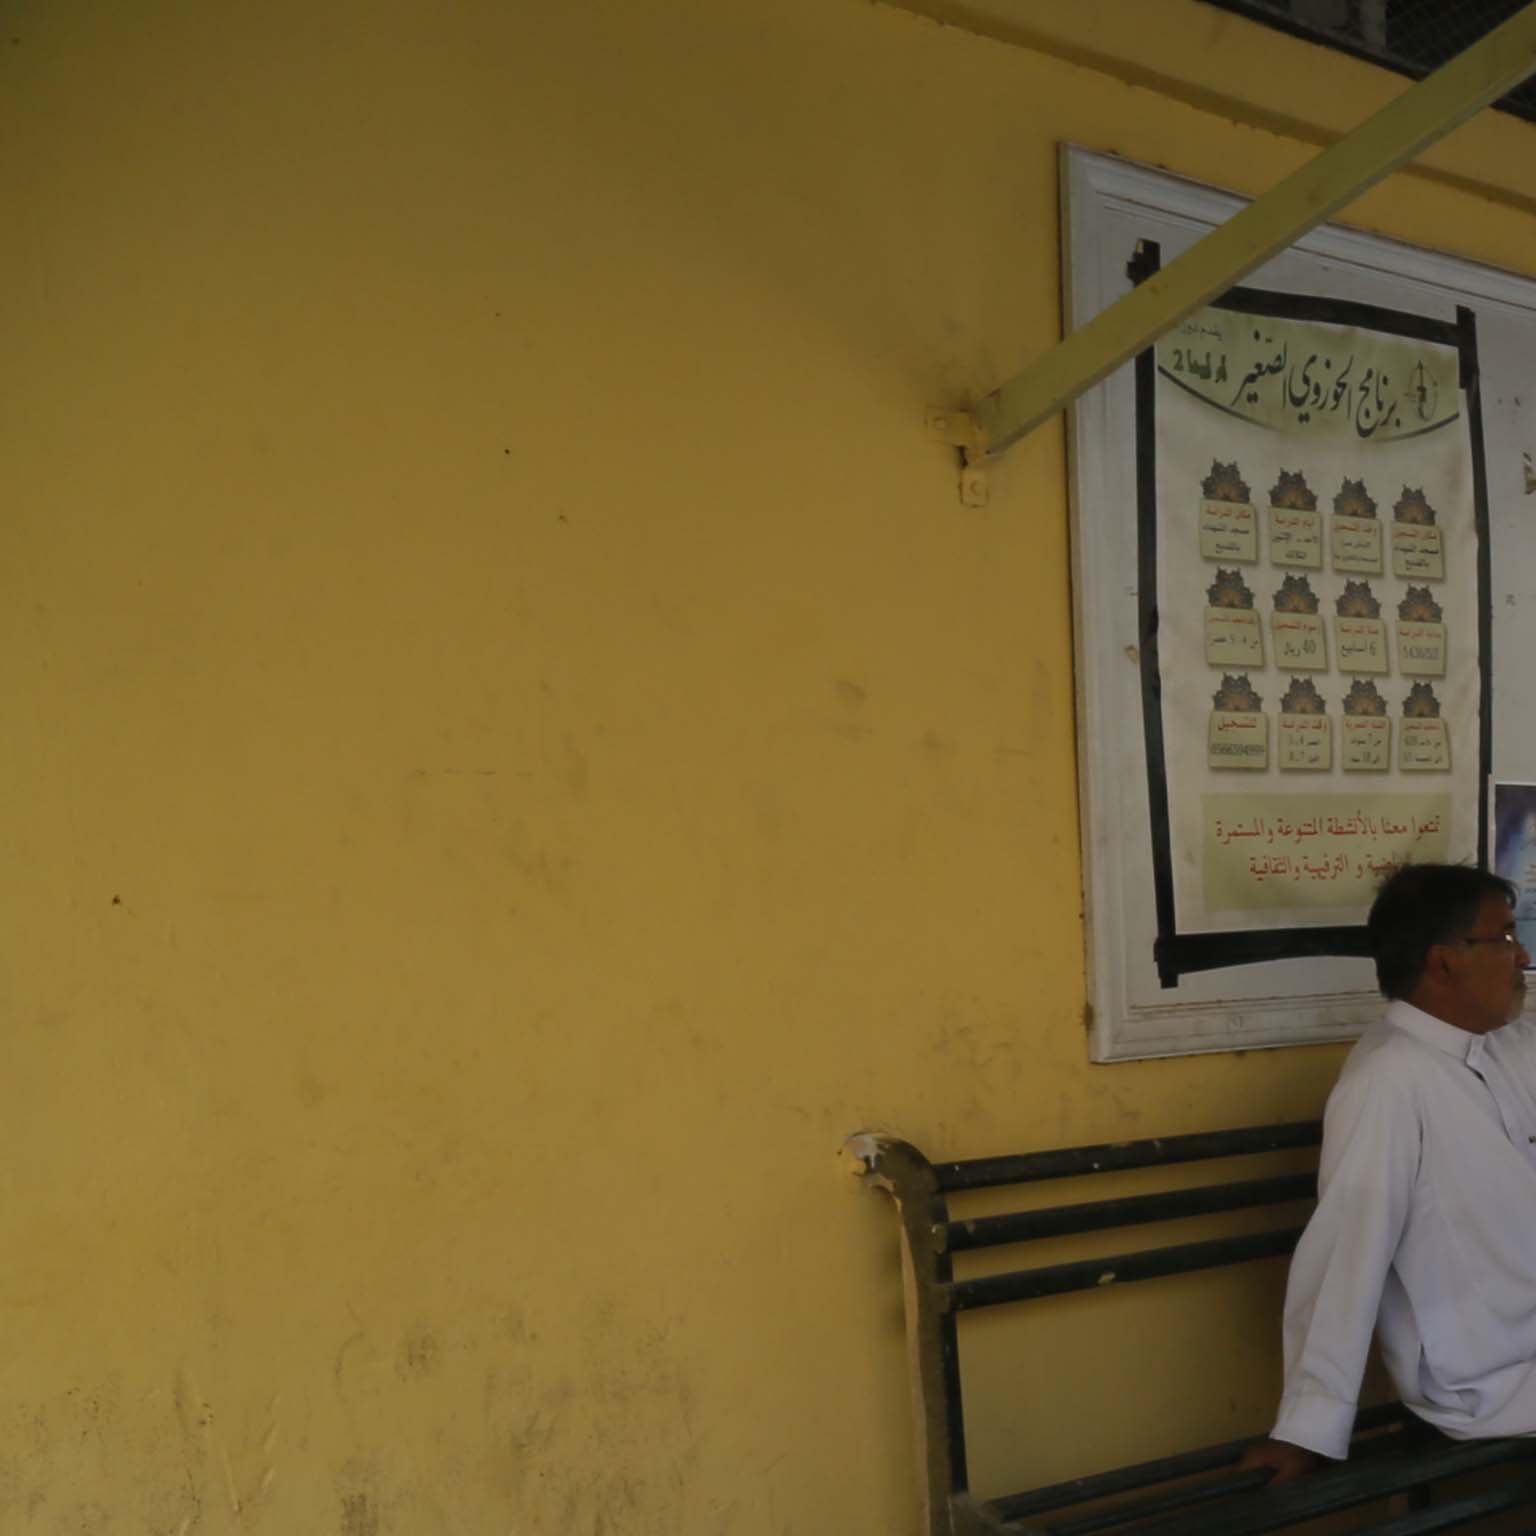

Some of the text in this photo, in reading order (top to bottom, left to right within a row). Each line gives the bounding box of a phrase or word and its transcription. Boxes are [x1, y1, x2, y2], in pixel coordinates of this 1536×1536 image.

[1231, 328, 1288, 408] الصغير
[1356, 367, 1401, 438] برنامج
[1380, 815, 1408, 836] معنا
